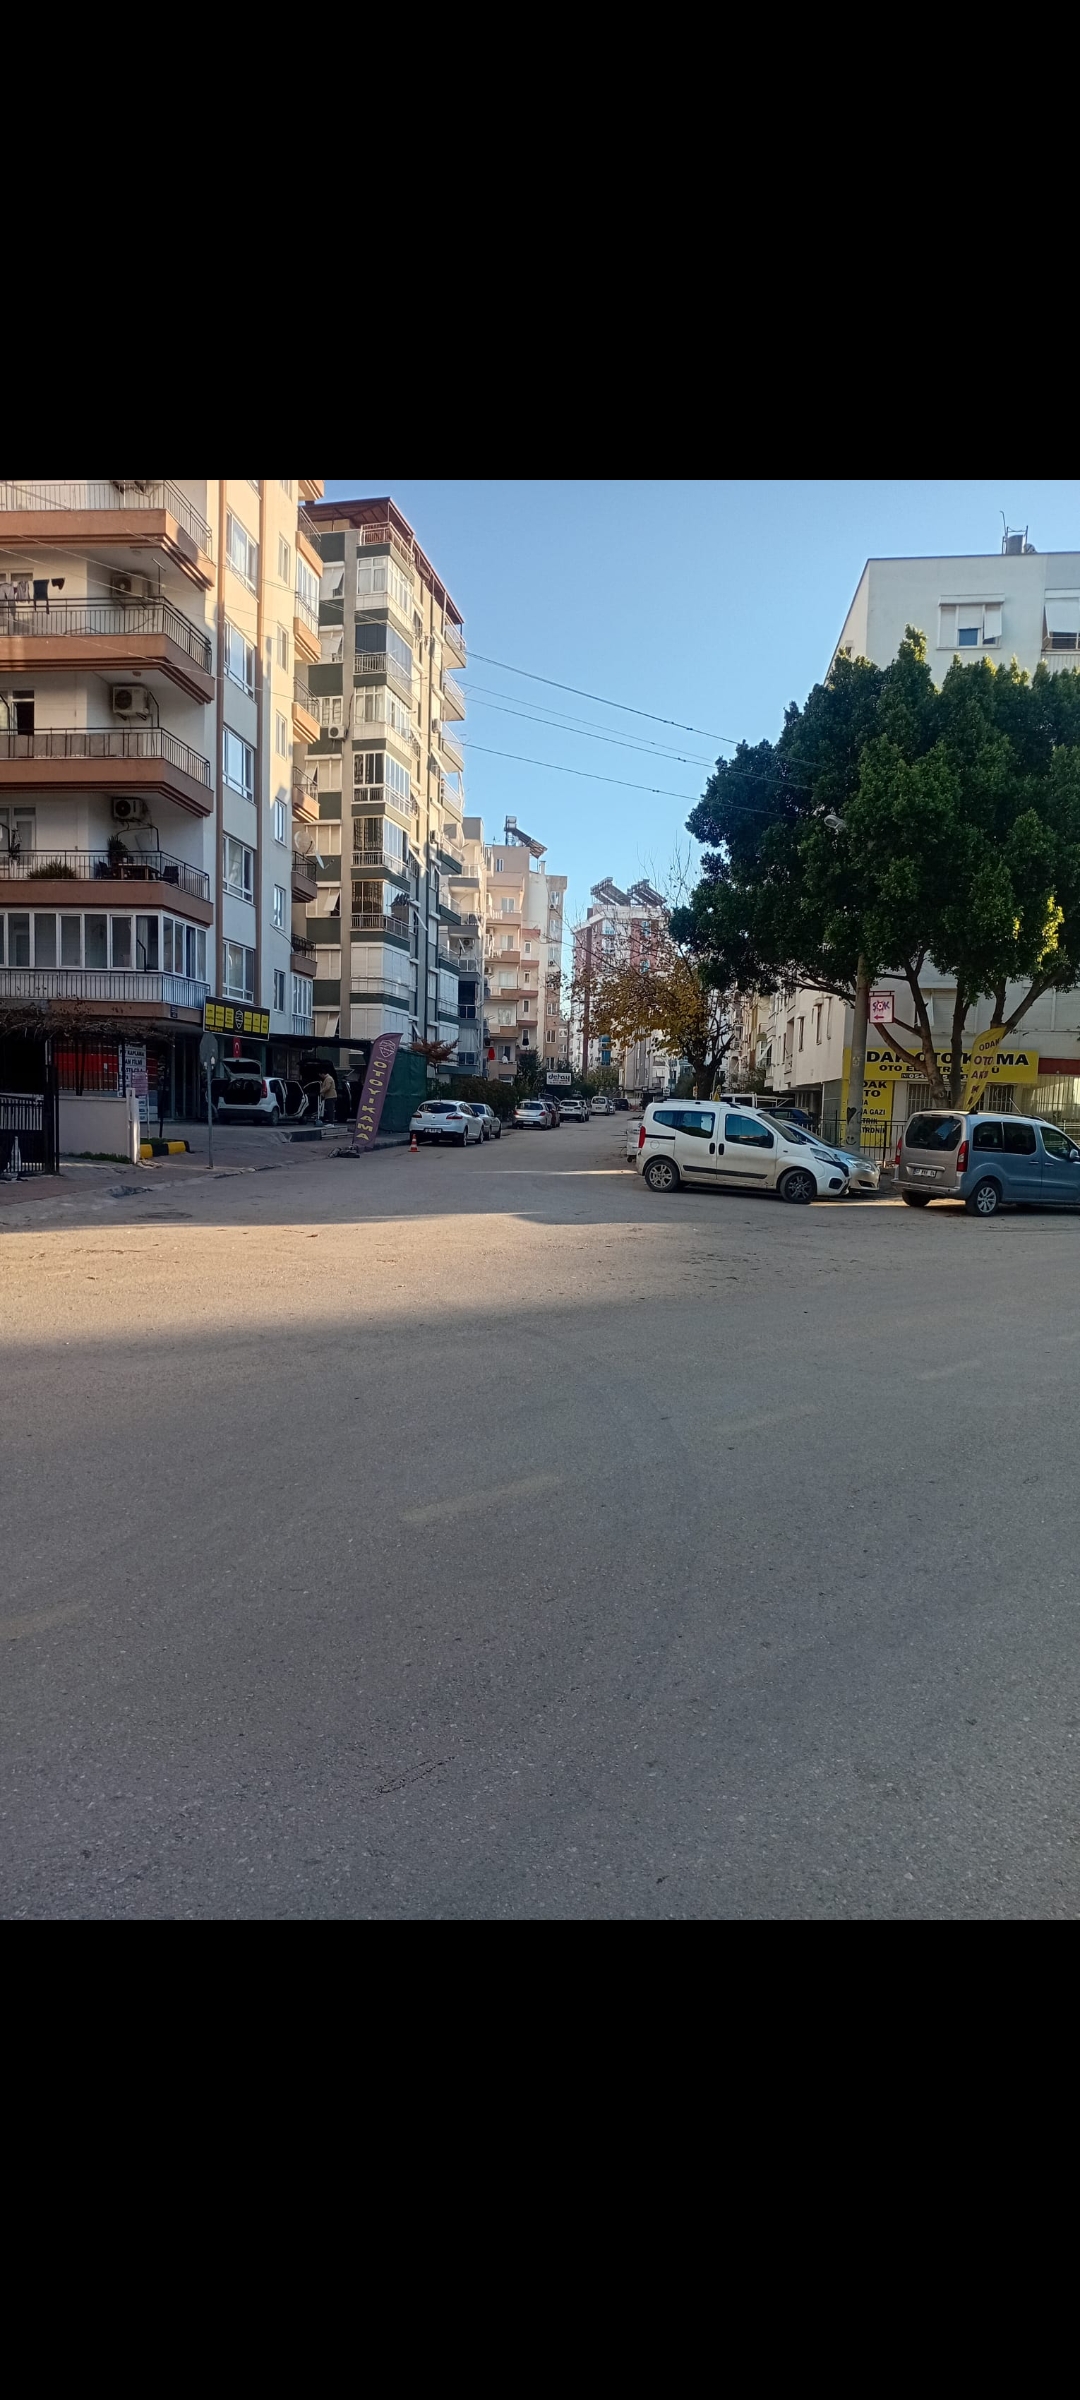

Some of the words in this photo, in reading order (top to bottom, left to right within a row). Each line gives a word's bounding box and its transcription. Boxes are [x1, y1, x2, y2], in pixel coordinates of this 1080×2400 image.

[866, 1051, 904, 1063] DAK
[879, 1064, 902, 1072] OTO
[862, 1080, 887, 1088] DAK
[863, 1089, 881, 1098] TO
